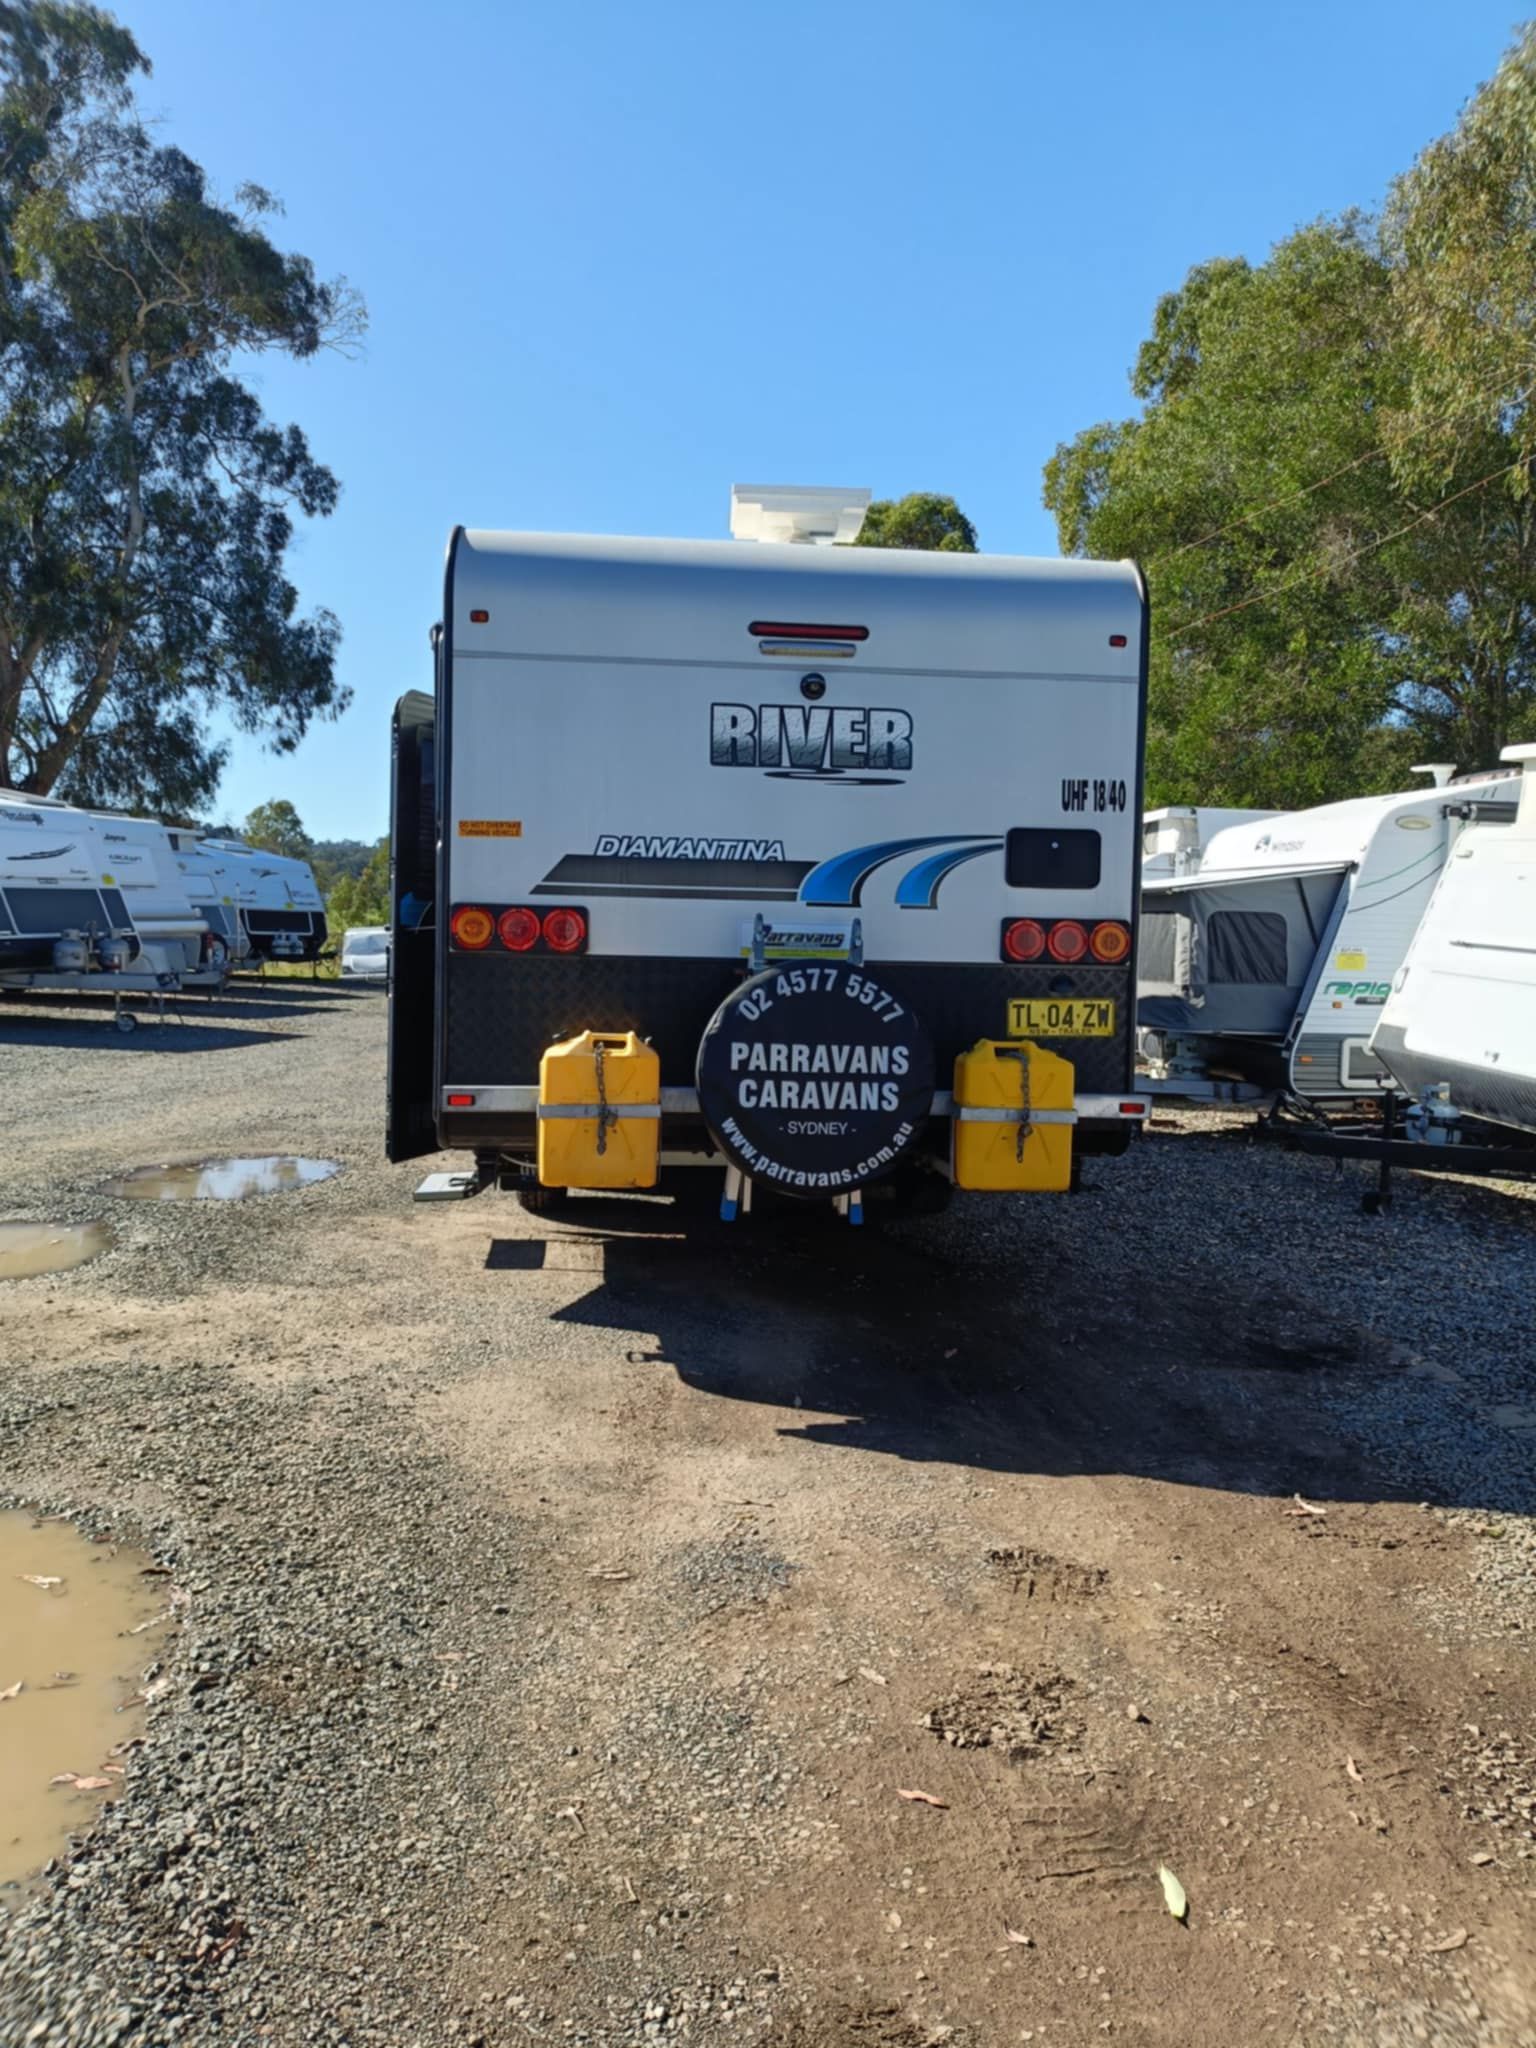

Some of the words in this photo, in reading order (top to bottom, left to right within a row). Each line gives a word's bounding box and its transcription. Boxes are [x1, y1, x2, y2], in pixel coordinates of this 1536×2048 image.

[710, 702, 913, 771] RIVER
[1062, 779, 1089, 812] UHF
[595, 834, 785, 862] DIAMANTINA
[738, 988, 774, 1021] 02
[776, 968, 838, 997] 4577
[845, 974, 905, 1023] 5577
[730, 1042, 910, 1075] PARRAVANS
[738, 1079, 900, 1112] CARAVANS
[787, 1121, 849, 1136] SYDNEY
[721, 1117, 914, 1188] www.parravans.com.au
